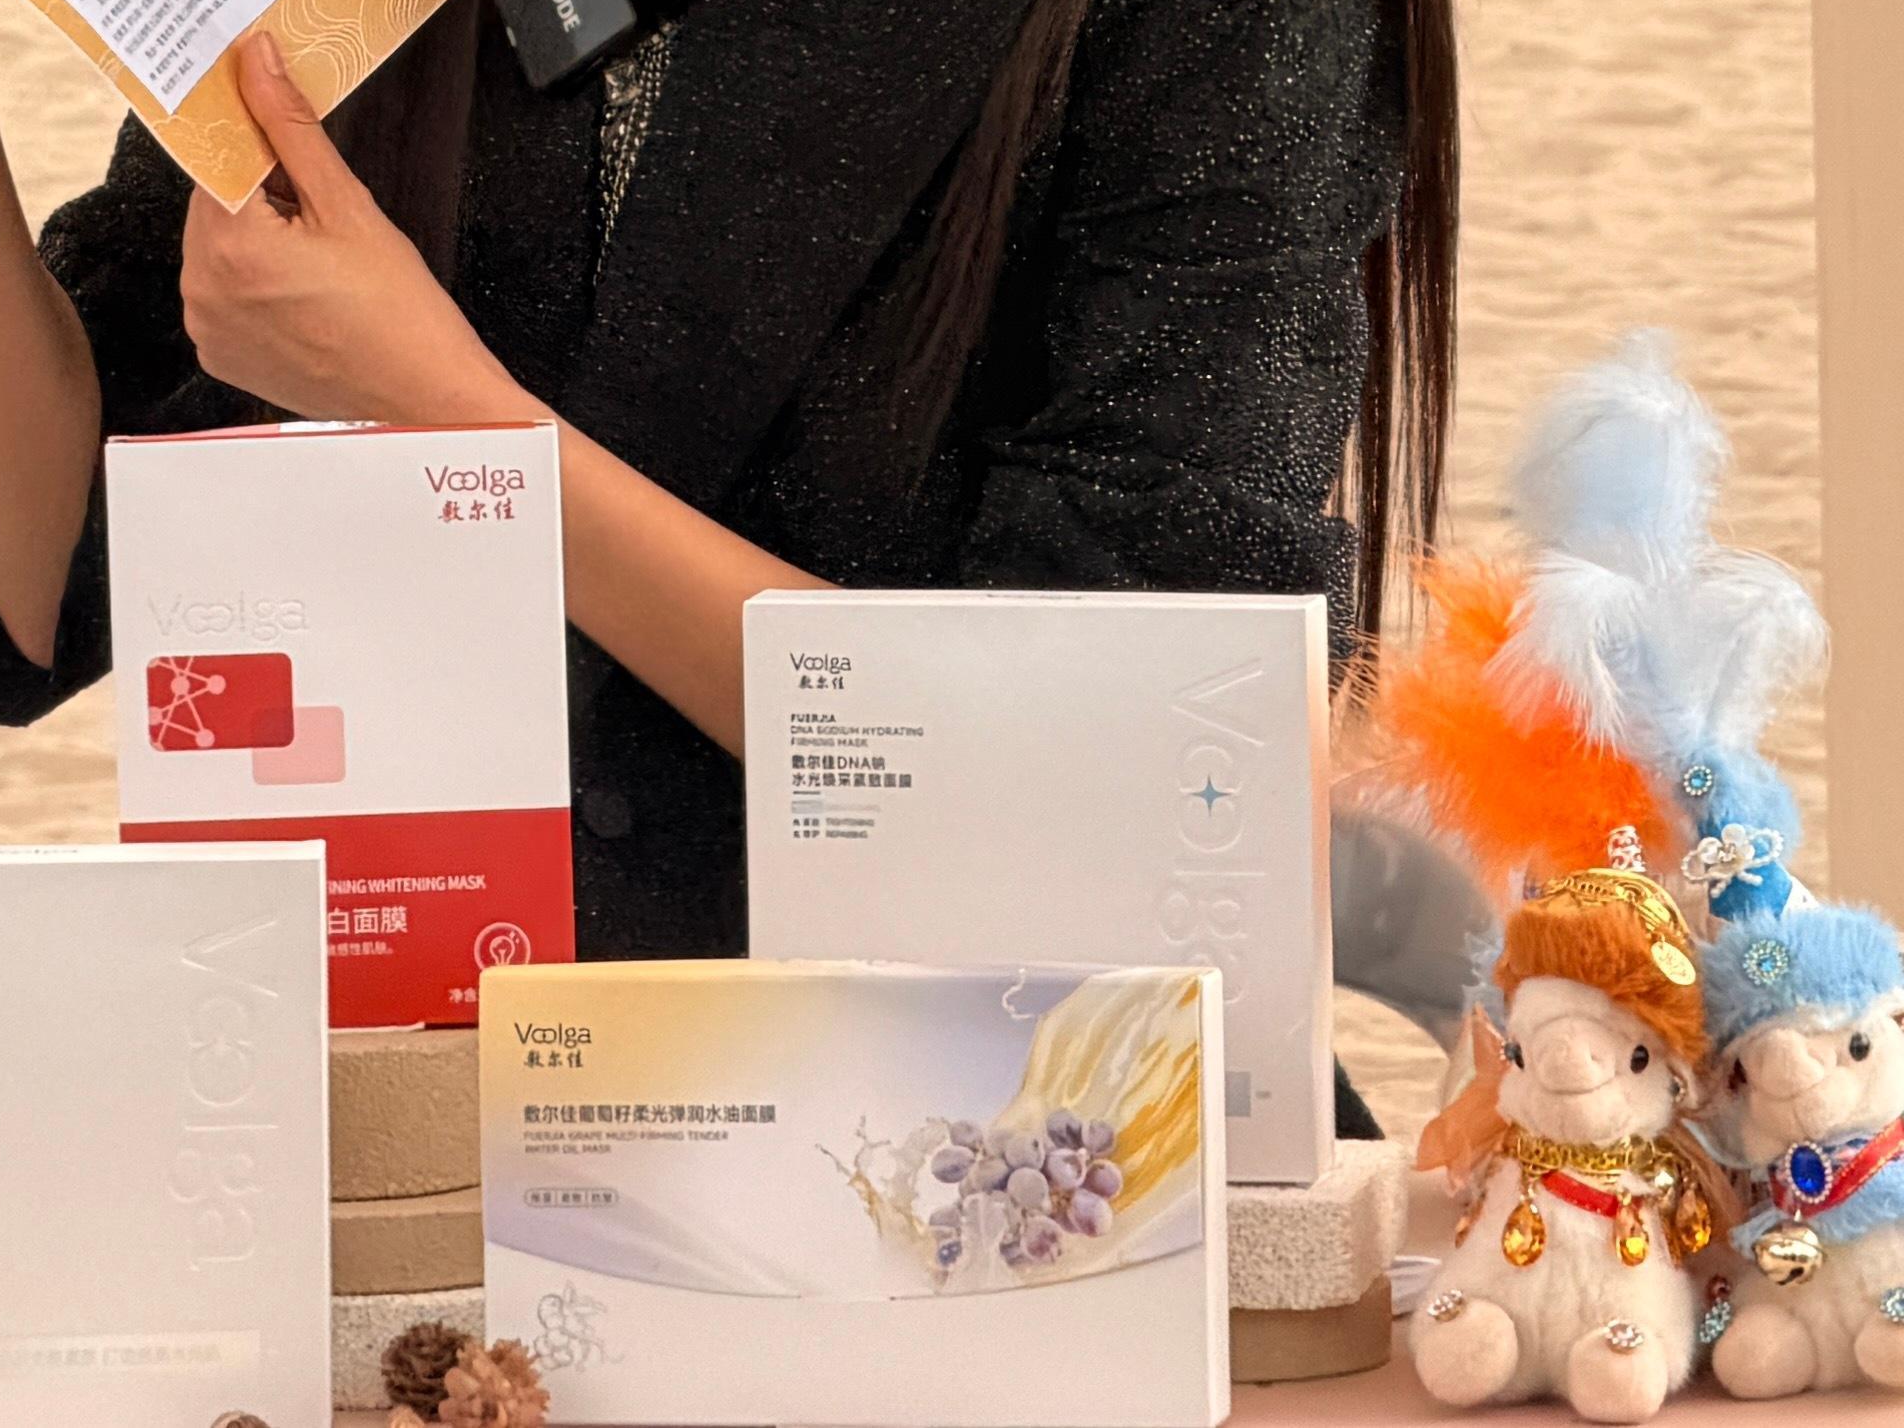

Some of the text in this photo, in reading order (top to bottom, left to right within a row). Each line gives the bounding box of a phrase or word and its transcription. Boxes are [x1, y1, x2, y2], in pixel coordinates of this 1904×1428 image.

[423, 464, 526, 496] Voolga
[438, 497, 516, 523] 敷尔佳
[146, 590, 310, 642] Voolga
[789, 652, 852, 674] Voolga
[861, 727, 925, 737] HYDRATING
[367, 876, 446, 892] WHITENING
[447, 874, 487, 890] MASK
[327, 905, 408, 935] 白面膜
[514, 1022, 592, 1049] Voolga
[523, 1049, 584, 1069] 敷尔佳
